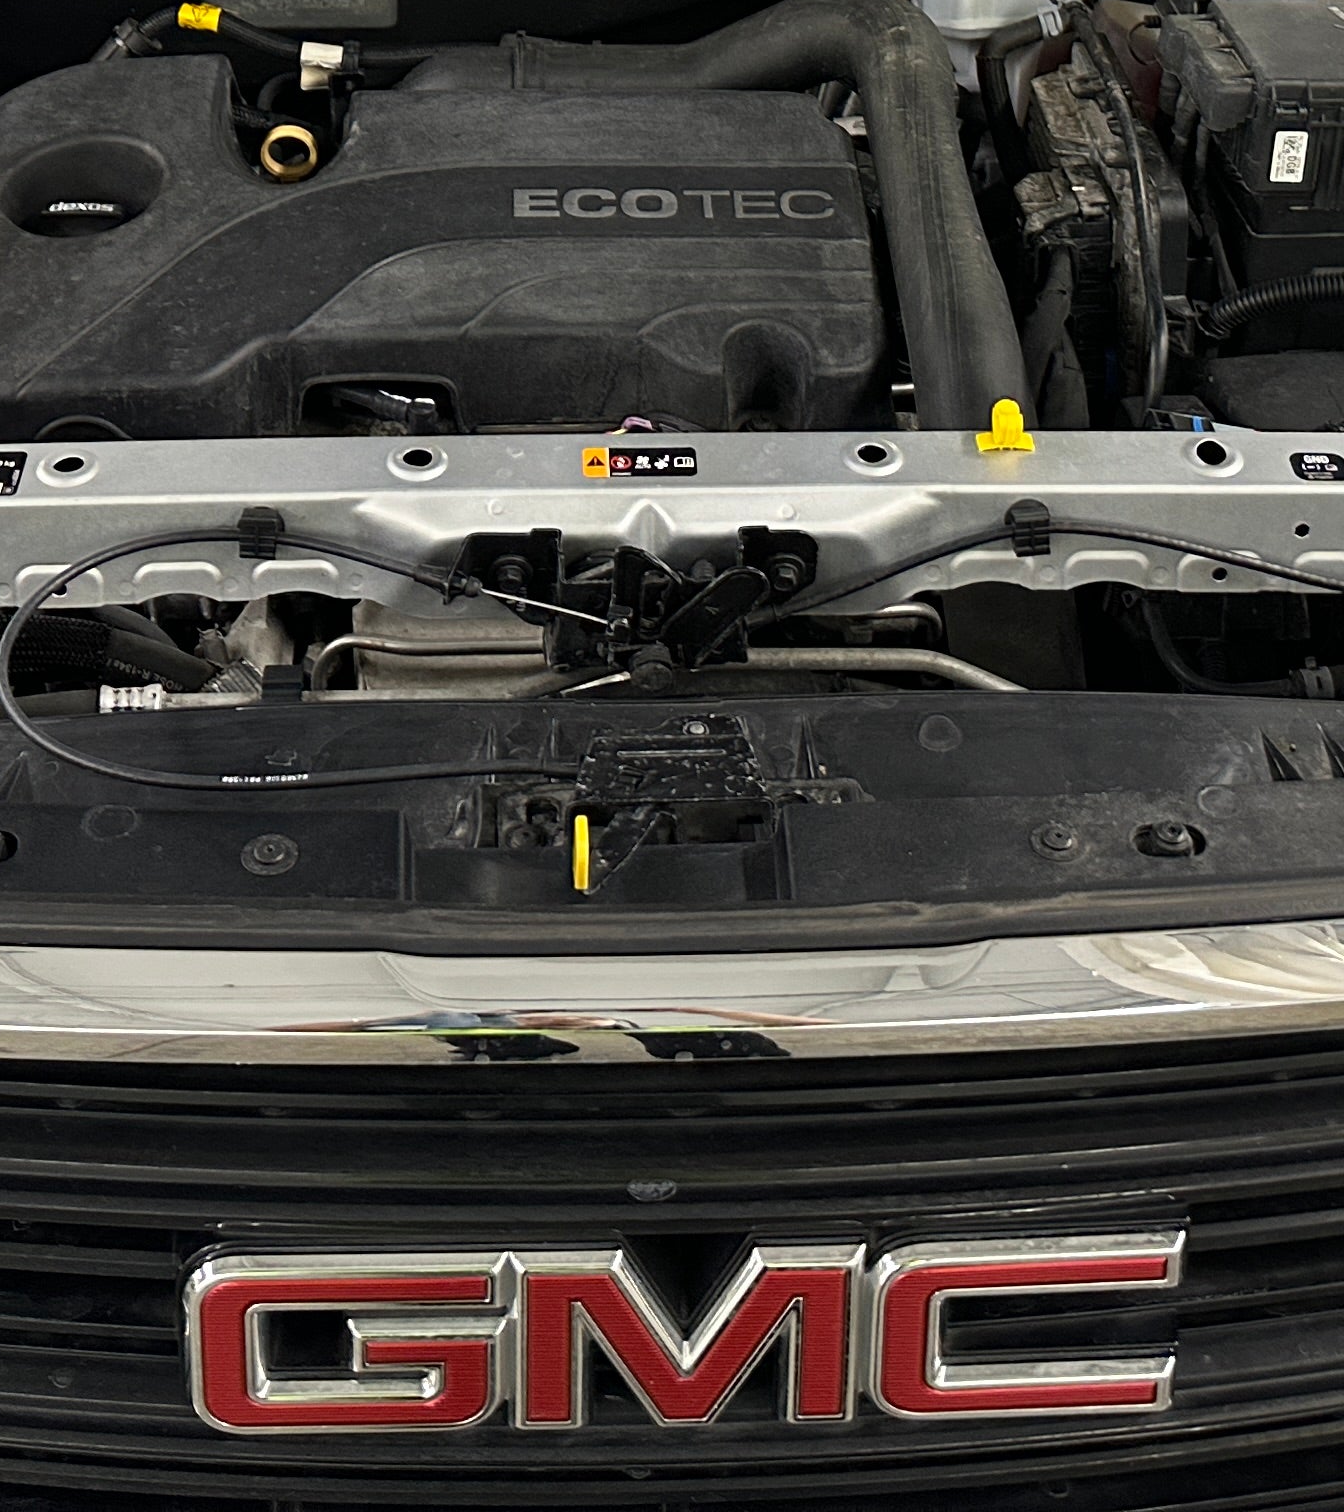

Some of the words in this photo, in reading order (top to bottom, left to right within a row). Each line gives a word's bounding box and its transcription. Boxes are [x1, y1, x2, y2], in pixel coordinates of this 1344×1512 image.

[48, 201, 115, 213] dexos
[512, 187, 835, 220] ECOTEC
[184, 1229, 1189, 1432] GMC
